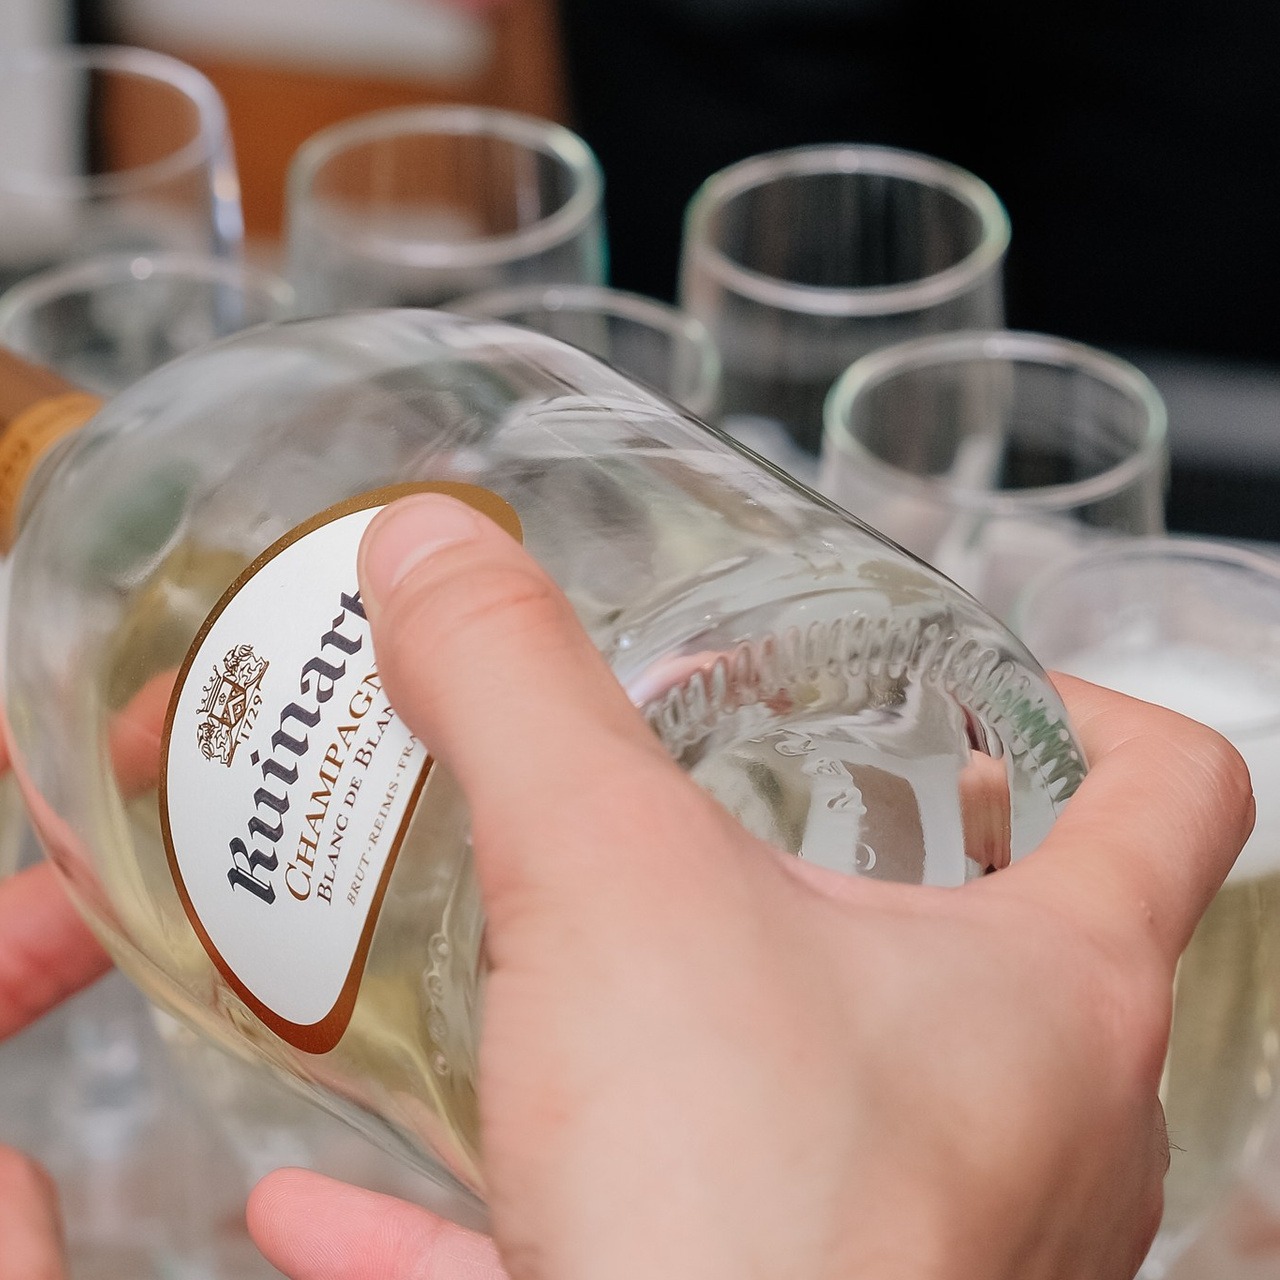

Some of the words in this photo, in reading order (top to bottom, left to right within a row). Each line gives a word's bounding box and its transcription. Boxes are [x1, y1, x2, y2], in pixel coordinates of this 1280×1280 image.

[240, 694, 263, 740] 1729
[352, 706, 394, 771] BLAN
[397, 735, 417, 770] FRA
[284, 663, 383, 901] CHAMPAGN
[344, 776, 363, 808] DE
[316, 813, 349, 906] BLANC
